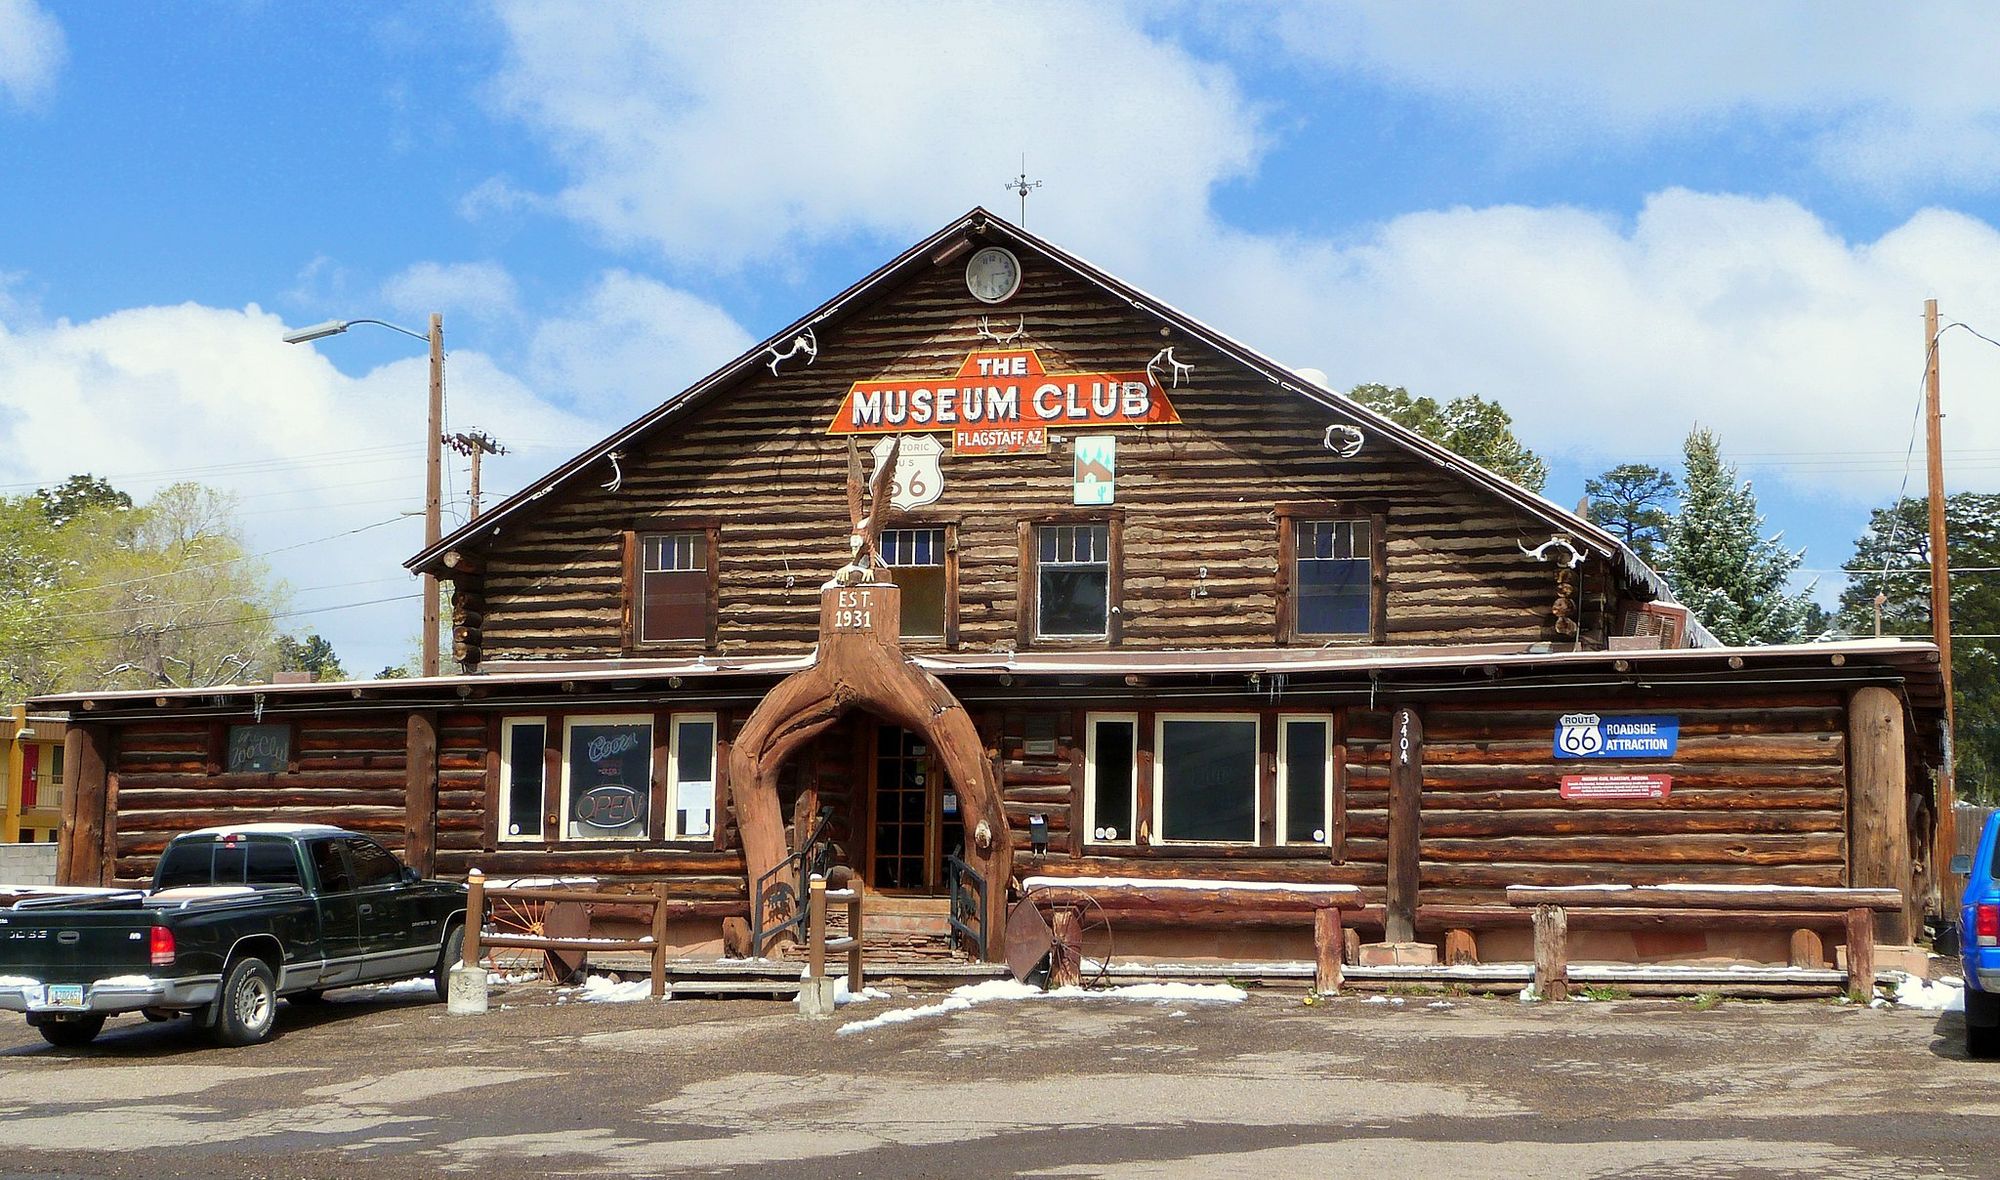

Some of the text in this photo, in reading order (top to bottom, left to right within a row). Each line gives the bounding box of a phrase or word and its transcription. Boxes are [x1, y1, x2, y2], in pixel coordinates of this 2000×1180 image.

[977, 356, 1027, 376] THE
[852, 381, 1150, 425] MUSEUM CLUB
[886, 443, 930, 452] HTORIC
[957, 430, 1043, 447] FLAGSTAFF, AZ
[838, 590, 874, 608] EST.
[834, 610, 872, 628] 1931
[1565, 716, 1595, 724] ROUTE
[1606, 723, 1657, 735] ROADSIDE
[1400, 711, 1410, 763] 3404
[1566, 727, 1596, 751] 66
[1605, 738, 1668, 751] ATTRACTION
[577, 794, 645, 820] OPEN
